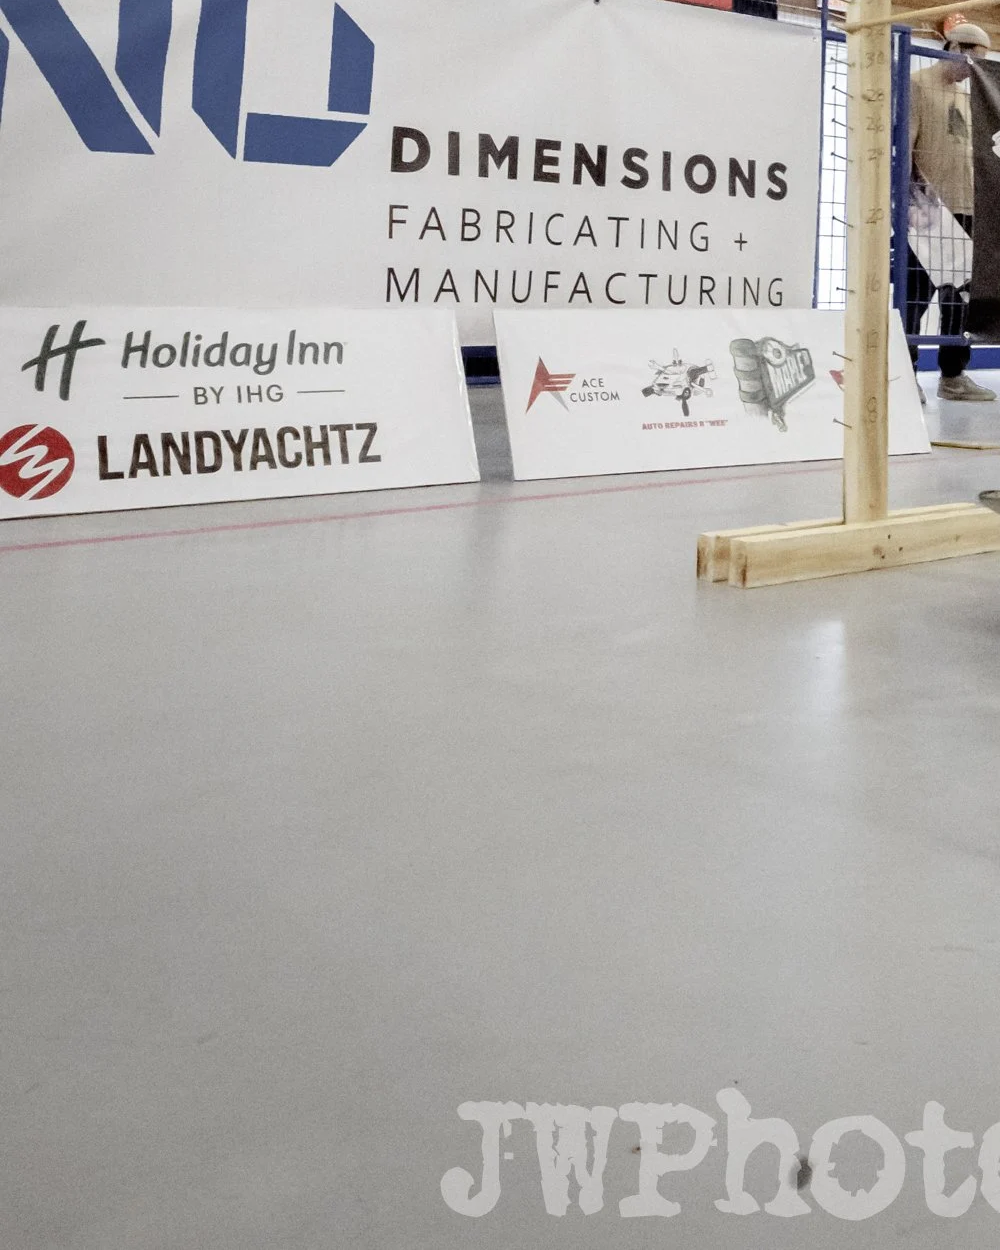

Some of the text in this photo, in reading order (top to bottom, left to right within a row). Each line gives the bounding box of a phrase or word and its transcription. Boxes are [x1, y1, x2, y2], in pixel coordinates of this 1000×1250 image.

[390, 126, 789, 201] DIMENSIONS
[387, 204, 750, 252] FABRICATING +
[385, 267, 786, 307] MANUFACTURING
[121, 330, 344, 376] Holiday Inn
[193, 384, 284, 405] BY IHG
[570, 390, 620, 403] CUSTOM
[582, 378, 605, 389] ACE
[642, 422, 663, 431] AUTO
[665, 420, 698, 429] REPAIRS
[98, 422, 382, 481] LANDYACHTZ
